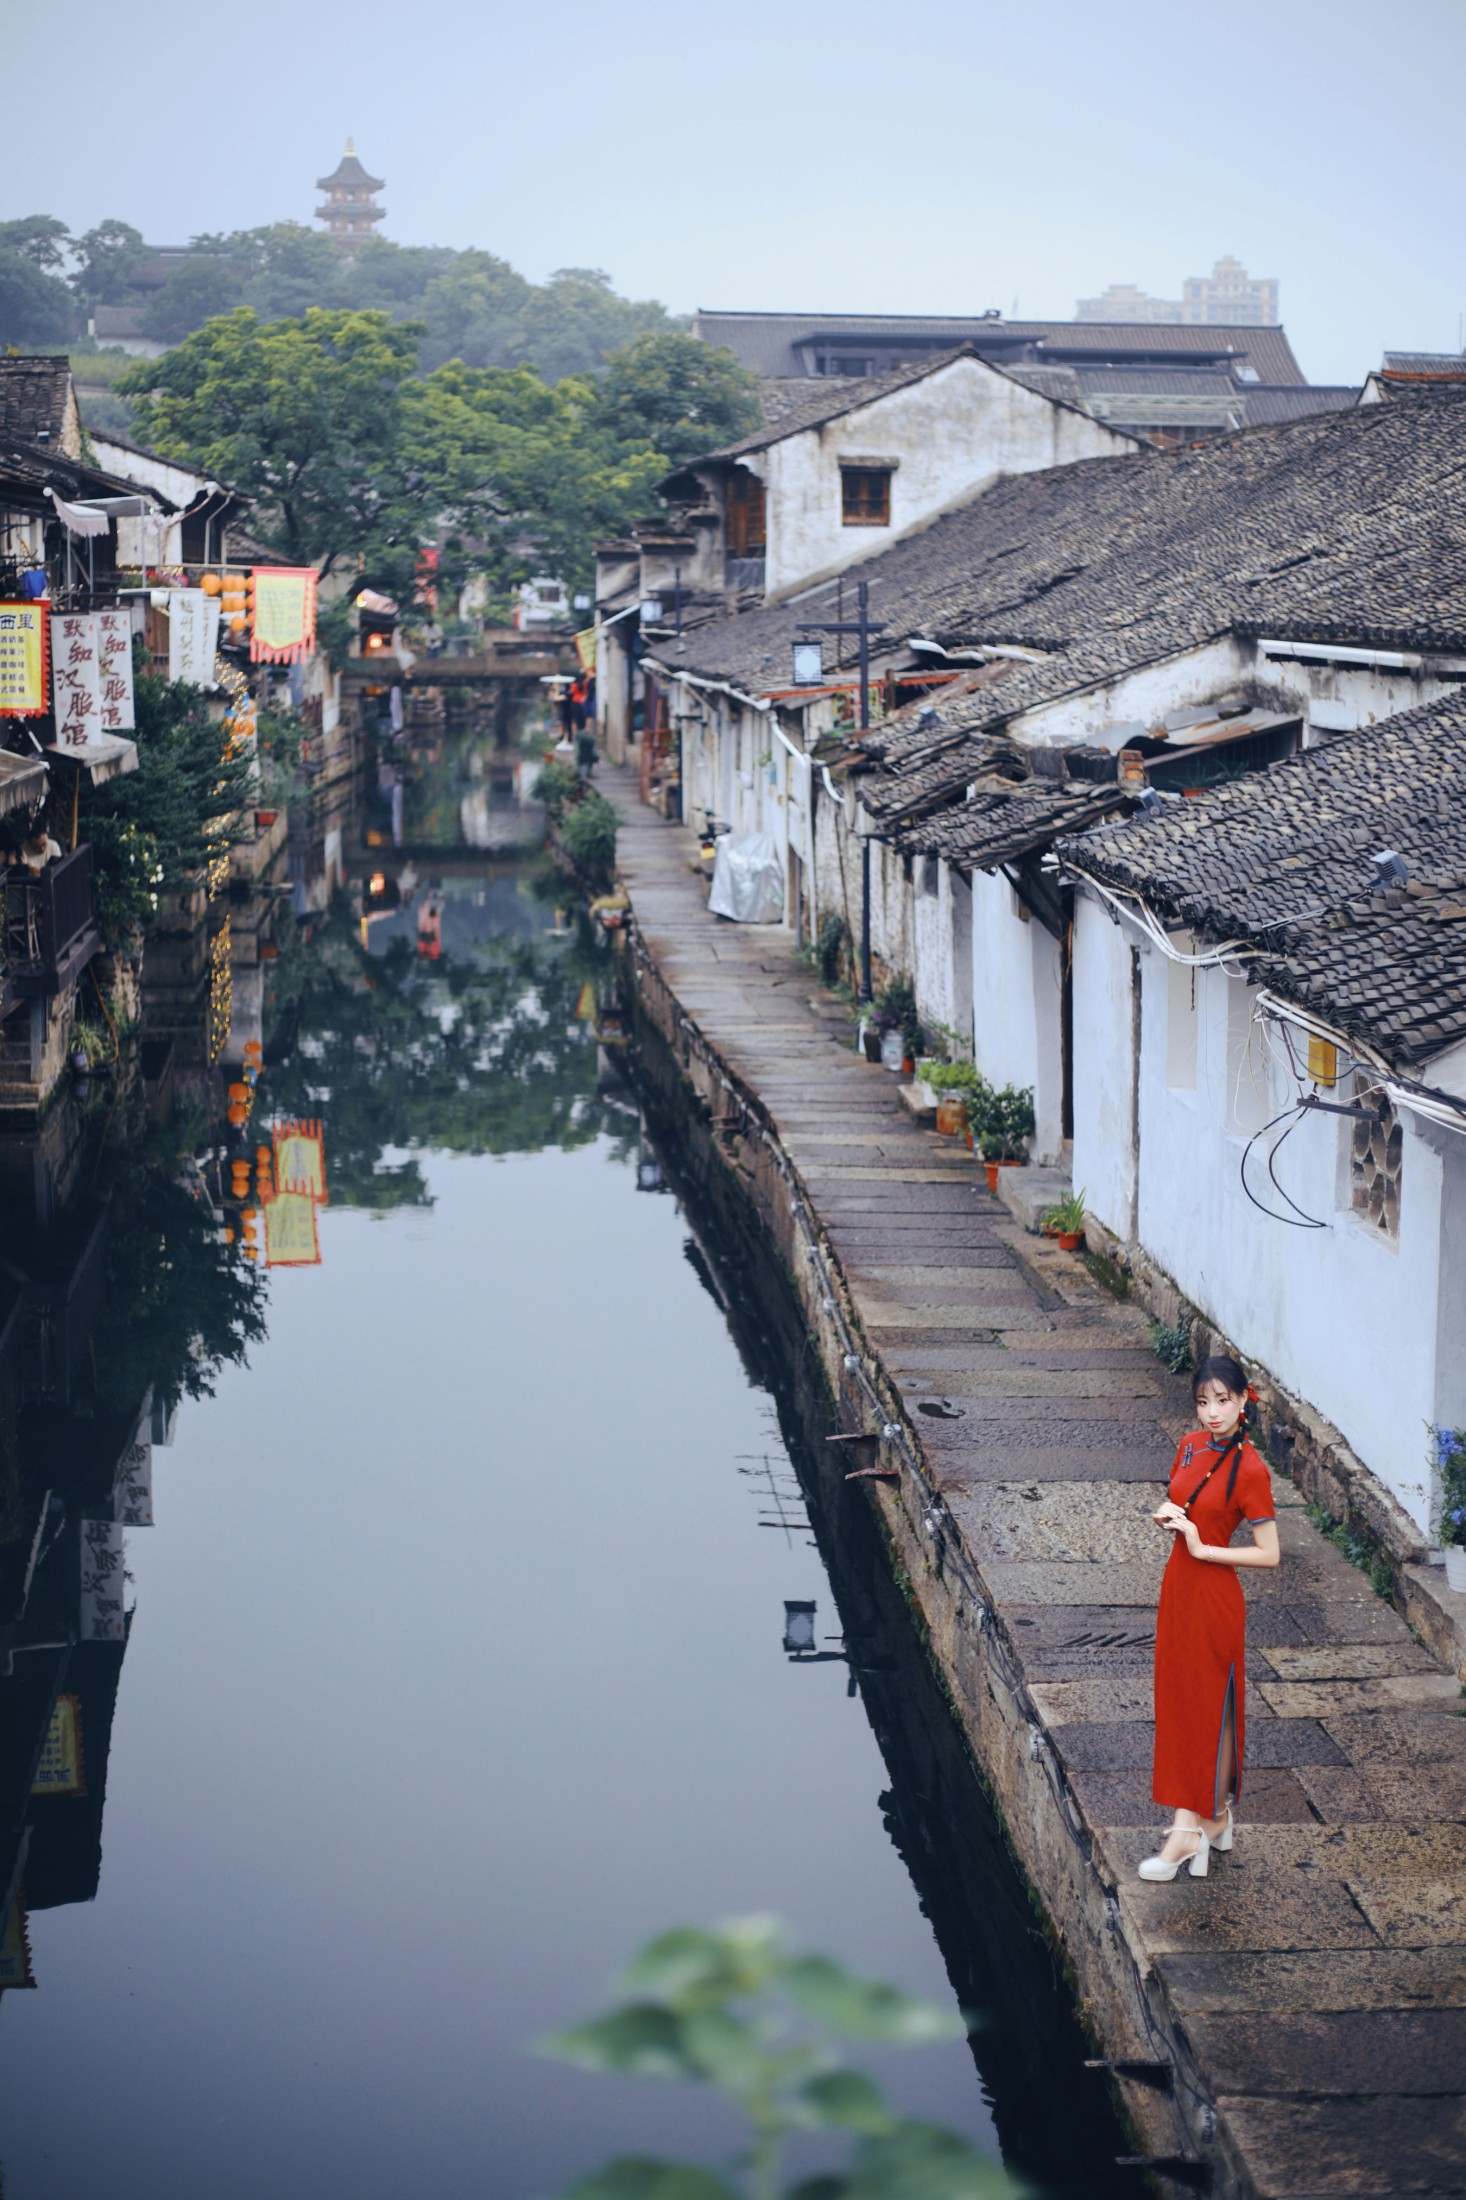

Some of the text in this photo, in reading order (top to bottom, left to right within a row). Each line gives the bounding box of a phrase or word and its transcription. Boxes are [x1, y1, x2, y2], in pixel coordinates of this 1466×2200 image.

[0, 613, 34, 630] 西里
[55, 618, 98, 746] 默知汉服馆
